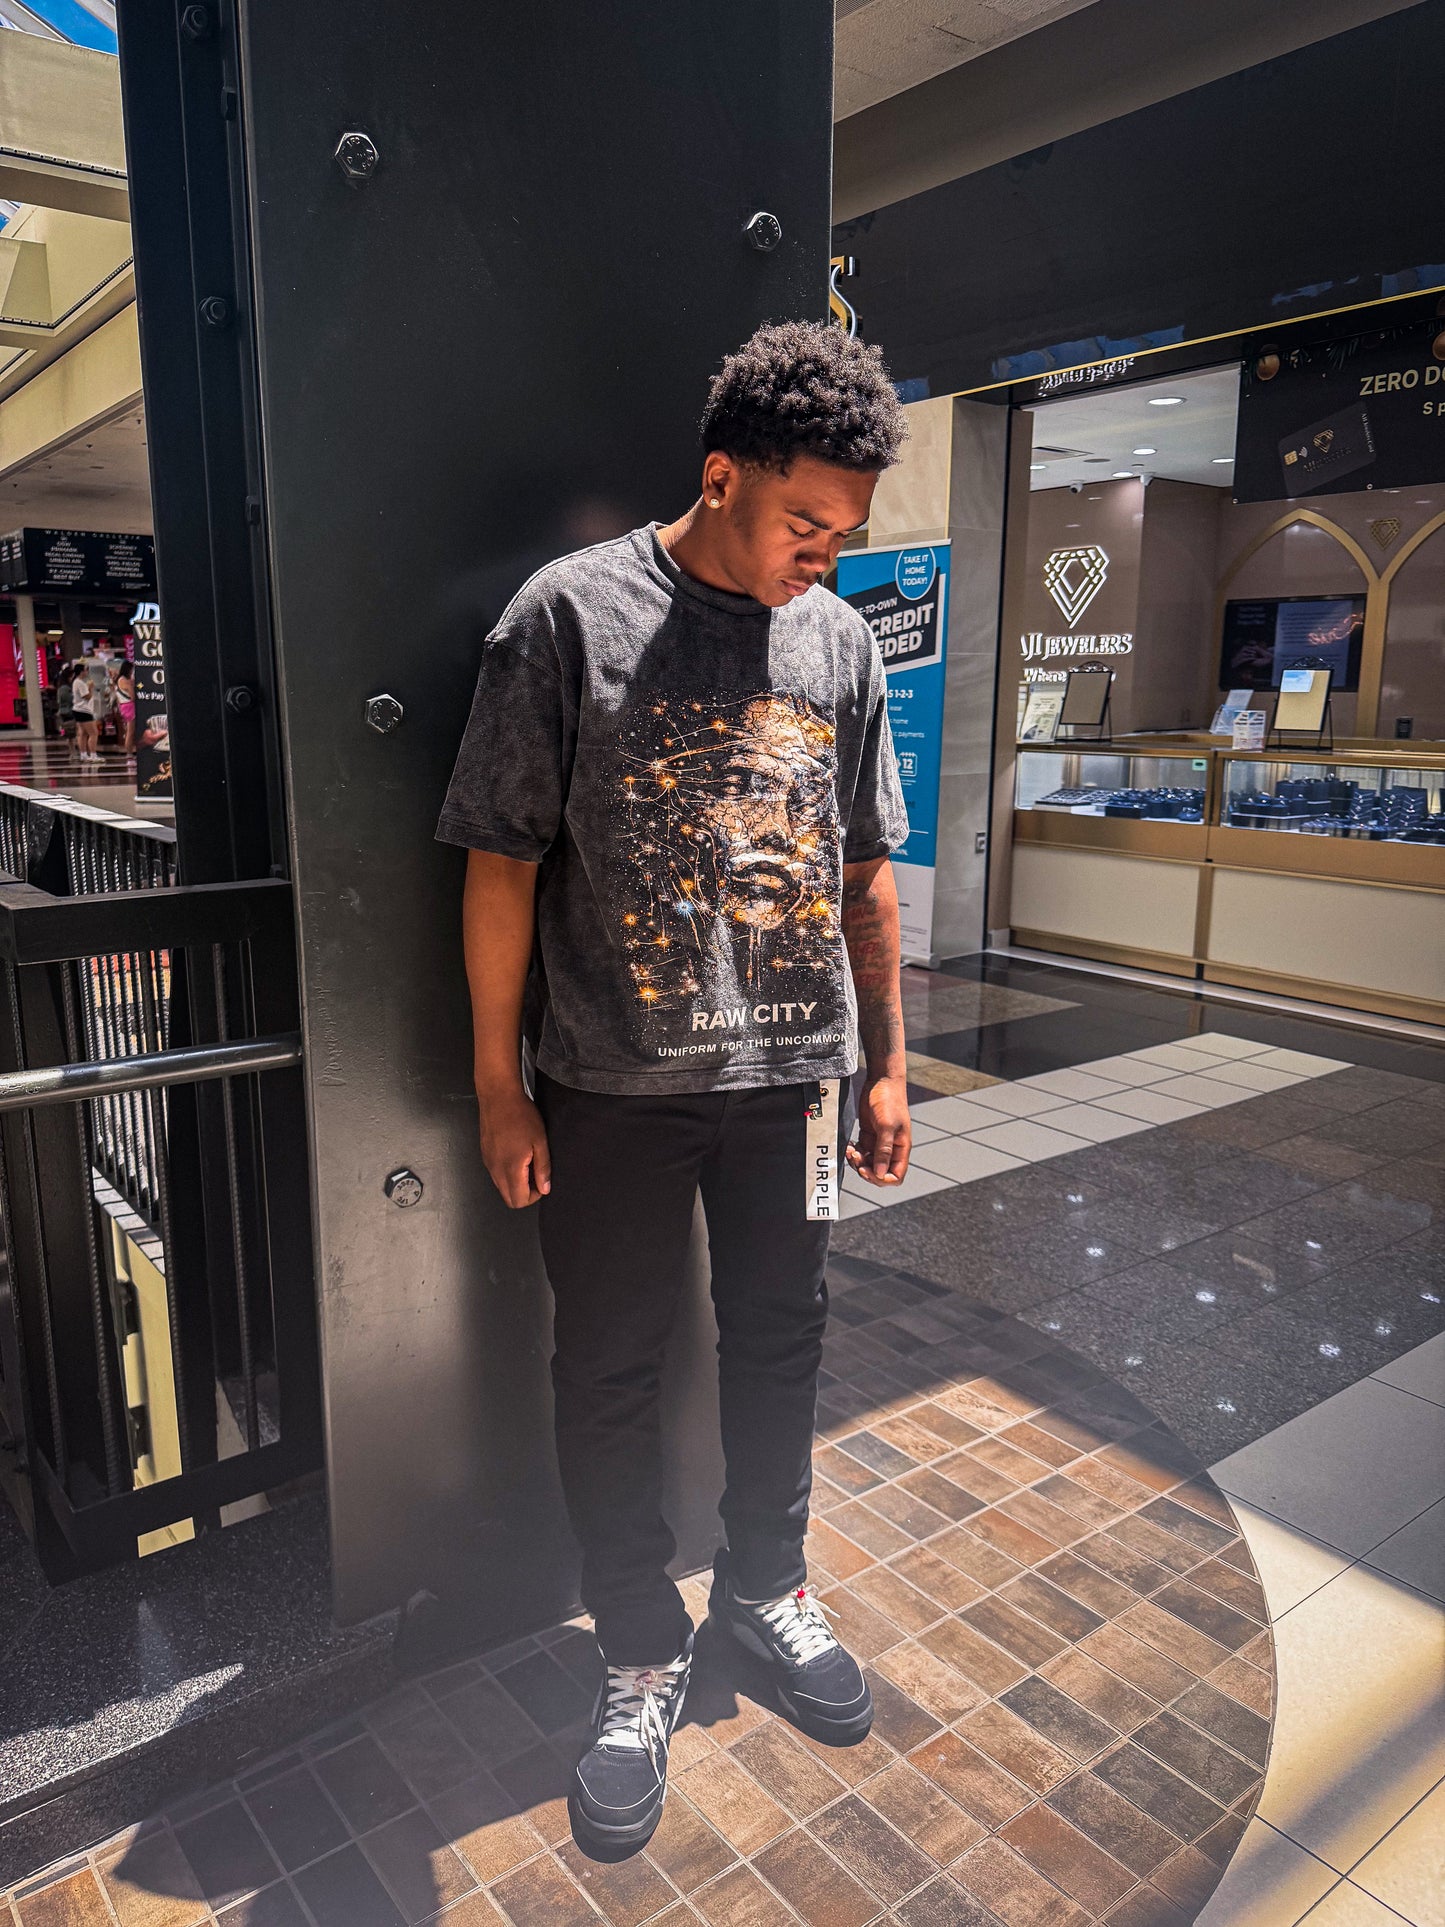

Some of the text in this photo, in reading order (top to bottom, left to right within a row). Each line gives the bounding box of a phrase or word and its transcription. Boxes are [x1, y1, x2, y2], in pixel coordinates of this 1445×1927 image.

[1359, 364, 1445, 397] ZERO D
[903, 554, 929, 564] TAKE IT
[904, 565, 927, 575] HOME
[902, 576, 928, 586] TODAY!
[869, 602, 935, 638] CREDIT
[1041, 633, 1133, 661] JEWELERS
[894, 689, 914, 699] 1-2-3
[902, 758, 913, 770] 12
[692, 1001, 818, 1032] RAW CITY
[658, 1043, 717, 1057] UNIFORM
[721, 1041, 743, 1052] FOR
[746, 1038, 772, 1048] THE
[816, 1145, 830, 1217] PURPLE
